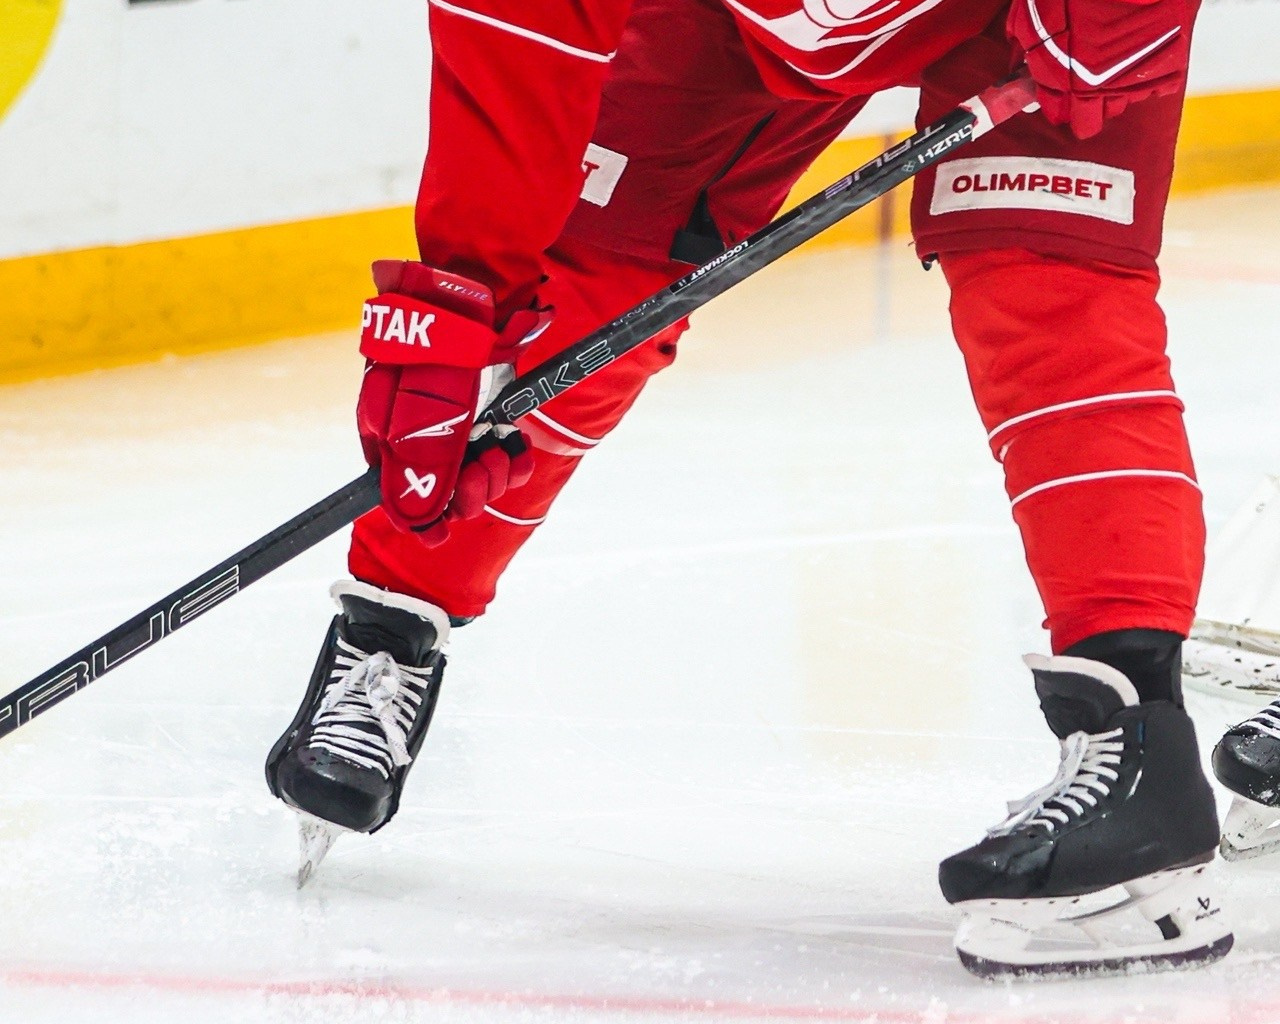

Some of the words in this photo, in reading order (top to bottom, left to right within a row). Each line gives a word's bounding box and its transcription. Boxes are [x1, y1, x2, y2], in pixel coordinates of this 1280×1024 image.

[825, 123, 946, 200] TRUE
[951, 172, 1113, 202] OLIMPBET
[691, 240, 749, 281] LOCKHART
[438, 280, 488, 302] FLYLITE
